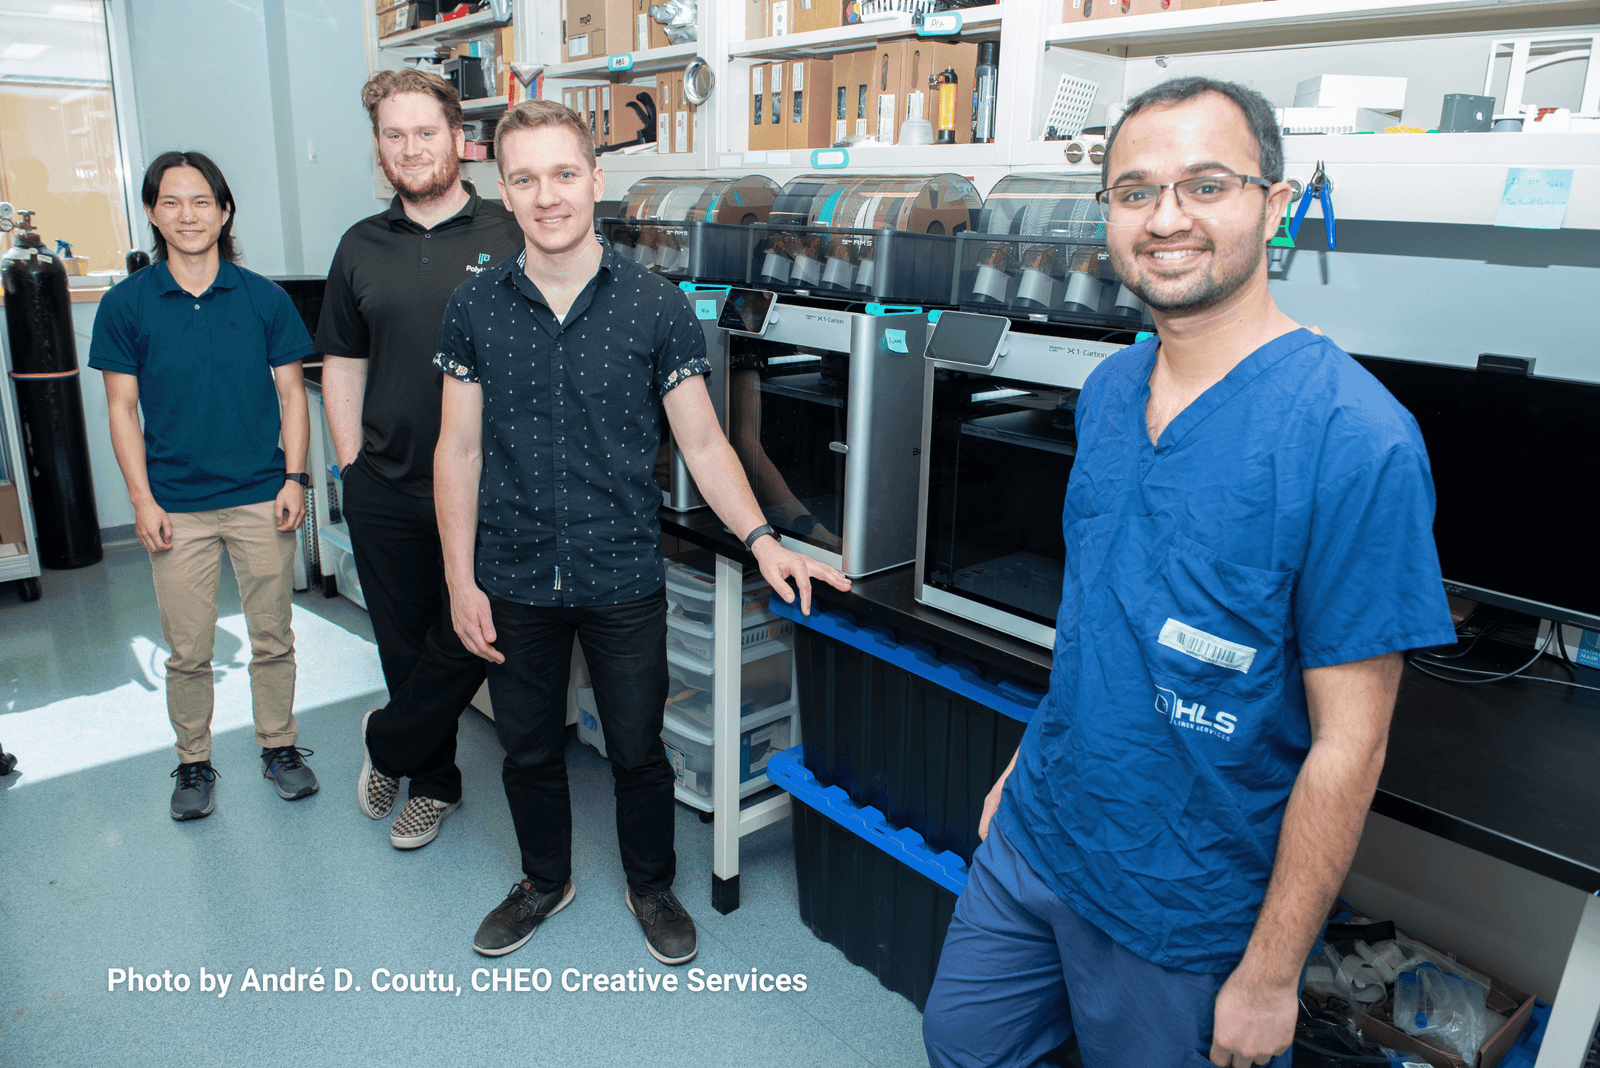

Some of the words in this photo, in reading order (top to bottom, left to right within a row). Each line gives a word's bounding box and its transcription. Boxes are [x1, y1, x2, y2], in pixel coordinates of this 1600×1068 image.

[853, 239, 872, 247] AMS
[1175, 698, 1238, 735] HLS
[1173, 720, 1195, 730] LINEN
[1196, 725, 1231, 741] SERVICES
